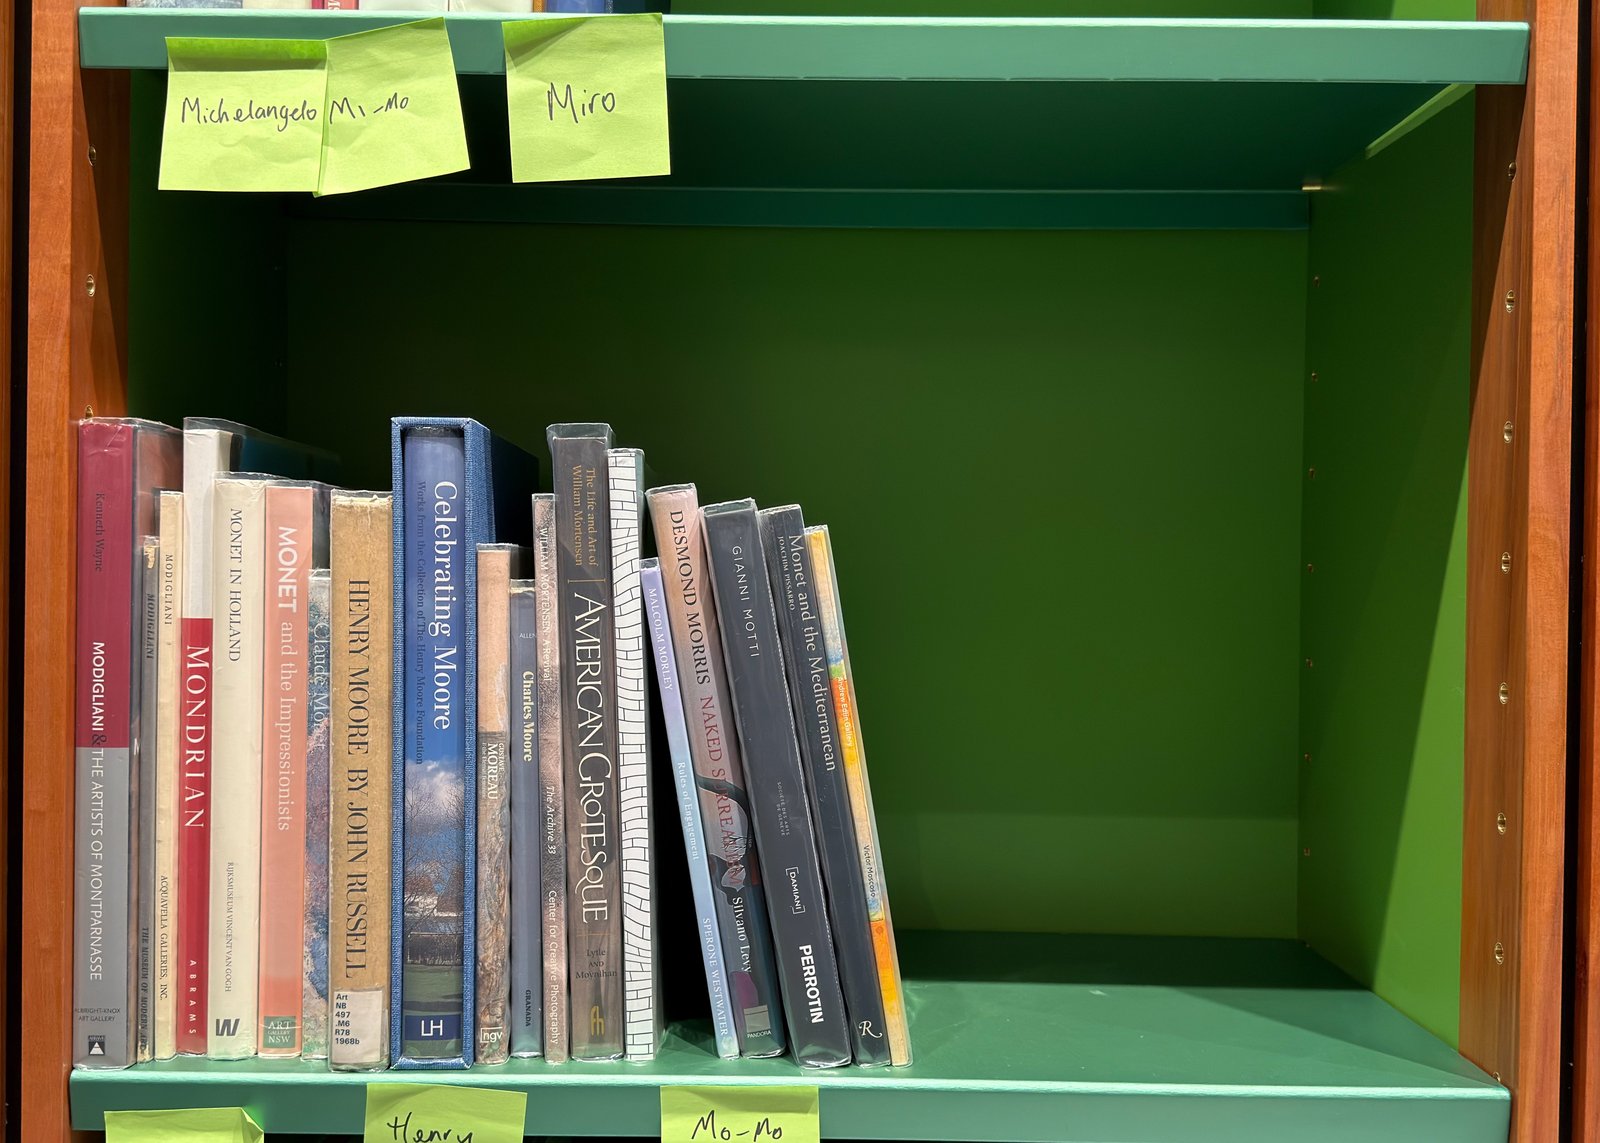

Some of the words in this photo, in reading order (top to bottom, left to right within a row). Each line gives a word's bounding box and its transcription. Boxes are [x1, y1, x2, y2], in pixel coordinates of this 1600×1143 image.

[181, 97, 317, 132] Michelangelo
[547, 82, 615, 123] Miro
[572, 464, 582, 507] William
[586, 468, 596, 487] The
[417, 481, 426, 512] Works
[587, 491, 597, 511] Life
[95, 493, 105, 535] Kenneth
[416, 515, 426, 538] from
[588, 514, 597, 533] and
[230, 508, 243, 563] MONET
[416, 541, 426, 556] the
[539, 527, 550, 570] WILLIAM
[575, 510, 584, 566] Mortensen
[588, 537, 598, 554] Art
[93, 539, 105, 571] Wayne
[278, 526, 298, 613] MONET
[428, 481, 457, 637] Celebrating
[589, 556, 598, 566] of
[788, 534, 807, 588] Monet
[164, 554, 173, 626] MODIGLIANI
[230, 568, 243, 584] IN
[416, 558, 426, 607] Collection
[777, 535, 788, 571] JOACHIM
[784, 573, 795, 611] PISSARRO
[416, 611, 426, 619] of
[732, 545, 750, 601] GIANNI
[743, 608, 760, 658] MOTTI
[797, 593, 815, 621] and
[145, 593, 155, 660] MODIGLIANI
[229, 590, 242, 662] HOLLAND
[348, 578, 370, 660] HENRY
[416, 621, 426, 640] The
[670, 510, 697, 606] DESMOND
[685, 612, 711, 685] MORRIS
[700, 695, 723, 762] NAKED
[281, 622, 298, 655] and
[313, 622, 330, 686] Claude
[648, 588, 664, 643] MALCOLM
[658, 645, 673, 691] MORLEY
[803, 626, 818, 652] the
[414, 644, 425, 672] Henry
[543, 648, 552, 681] Revival
[575, 592, 607, 747] AMERICAN
[91, 642, 105, 731] MODIGLIANI
[281, 662, 297, 690] the
[416, 677, 425, 707] Moore
[433, 645, 457, 730] Moore
[836, 677, 847, 703] Andrew
[347, 666, 370, 755] MOORE
[522, 671, 534, 719] Charles
[840, 703, 849, 720] Edlin
[808, 657, 837, 771] Mediterranean
[91, 734, 107, 746] &
[184, 645, 210, 828] MONDRIAN
[415, 711, 426, 765] Foundation
[523, 721, 534, 762] Moore
[843, 721, 853, 747] Gallery
[91, 749, 104, 777] THE
[274, 697, 296, 831] Impressionists
[488, 743, 498, 799] MOREAU
[676, 761, 688, 788] Rules
[347, 767, 369, 797] BY
[546, 785, 555, 802] The
[682, 790, 691, 801] of
[90, 781, 104, 836] ARTISTS
[547, 806, 556, 842] Archive
[346, 802, 368, 863] JOHN
[575, 752, 612, 924] GROTESQUE
[683, 803, 700, 860] Engagement
[90, 840, 103, 860] OF
[547, 844, 556, 854] 33
[864, 845, 872, 866] Victor
[226, 861, 235, 913] RIJKSMUSEUM
[866, 867, 876, 898] Moscoso
[160, 876, 169, 929] ACQUAVELLA
[548, 890, 557, 921] Center
[732, 897, 750, 941] Silvano
[89, 864, 103, 981] MONTPARNASSE
[225, 914, 234, 949] VINCENT
[345, 872, 368, 978] RUSSELL
[549, 924, 558, 939] for
[141, 946, 149, 979] MUSEUM
[159, 933, 168, 980] GALLERIES,
[225, 949, 233, 966] VAN
[550, 941, 559, 980] Creative
[586, 949, 606, 959] Lytle
[738, 945, 753, 973] Levy
[141, 982, 148, 994] OF
[224, 968, 233, 992] GOGH
[575, 970, 618, 980] Moynihan
[702, 917, 718, 967] SPERONE
[711, 969, 729, 1036] WESTWATER
[799, 945, 824, 1024] PERROTIN
[159, 984, 168, 1001] INC.
[189, 959, 197, 1034] ABRAMS
[268, 1021, 291, 1029] ART
[548, 984, 560, 1043] Photography
[859, 1020, 883, 1038] R
[268, 1035, 291, 1043] NSW
[483, 1032, 503, 1042] ngv
[747, 1030, 771, 1038] PANDORA
[387, 1112, 473, 1143] Henry
